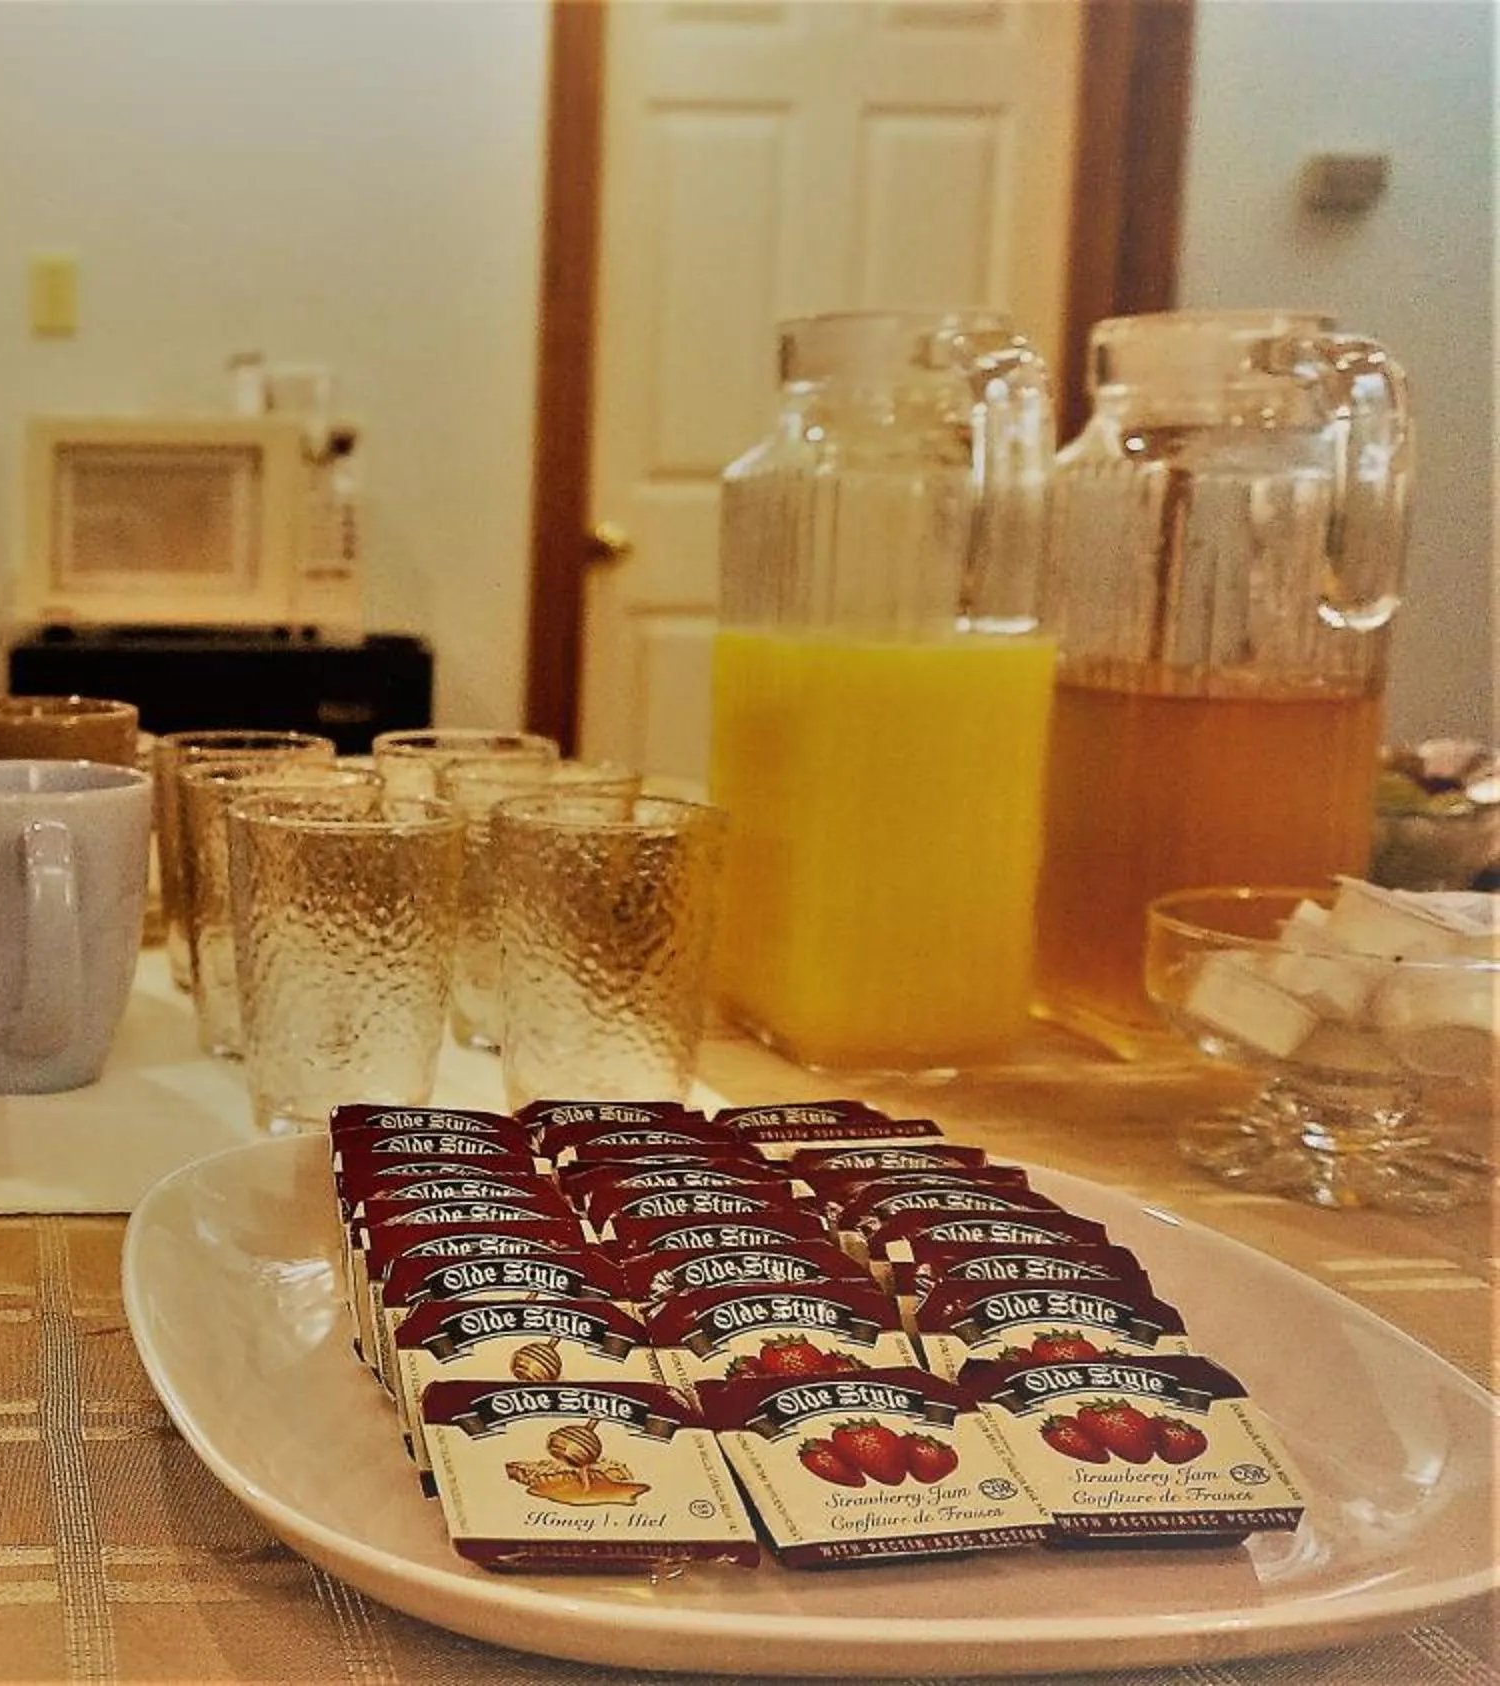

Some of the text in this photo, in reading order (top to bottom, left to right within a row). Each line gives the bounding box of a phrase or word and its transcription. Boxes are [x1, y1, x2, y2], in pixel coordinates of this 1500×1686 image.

[380, 1113, 425, 1130] Olde
[551, 1108, 595, 1125] Olde
[388, 1138, 435, 1154] Olde
[638, 1198, 689, 1218] Olde
[664, 1230, 715, 1250] Olde
[443, 1262, 570, 1291] Olde Style
[685, 1255, 807, 1286] Olde Style
[964, 1260, 1021, 1280] Olde
[712, 1299, 839, 1330] Olde Style
[985, 1293, 1119, 1323] Olde Style
[460, 1307, 593, 1338] Olde Style
[1025, 1365, 1165, 1393] Olde Style
[491, 1390, 633, 1419] Olde Style
[775, 1383, 911, 1415] Olde Style
[1069, 1466, 1220, 1488] Strawberry Jam
[825, 1486, 971, 1510] Strawberry Jam
[1159, 1487, 1178, 1502] de
[524, 1511, 597, 1532] Honey
[1226, 1511, 1298, 1526] PECTINE
